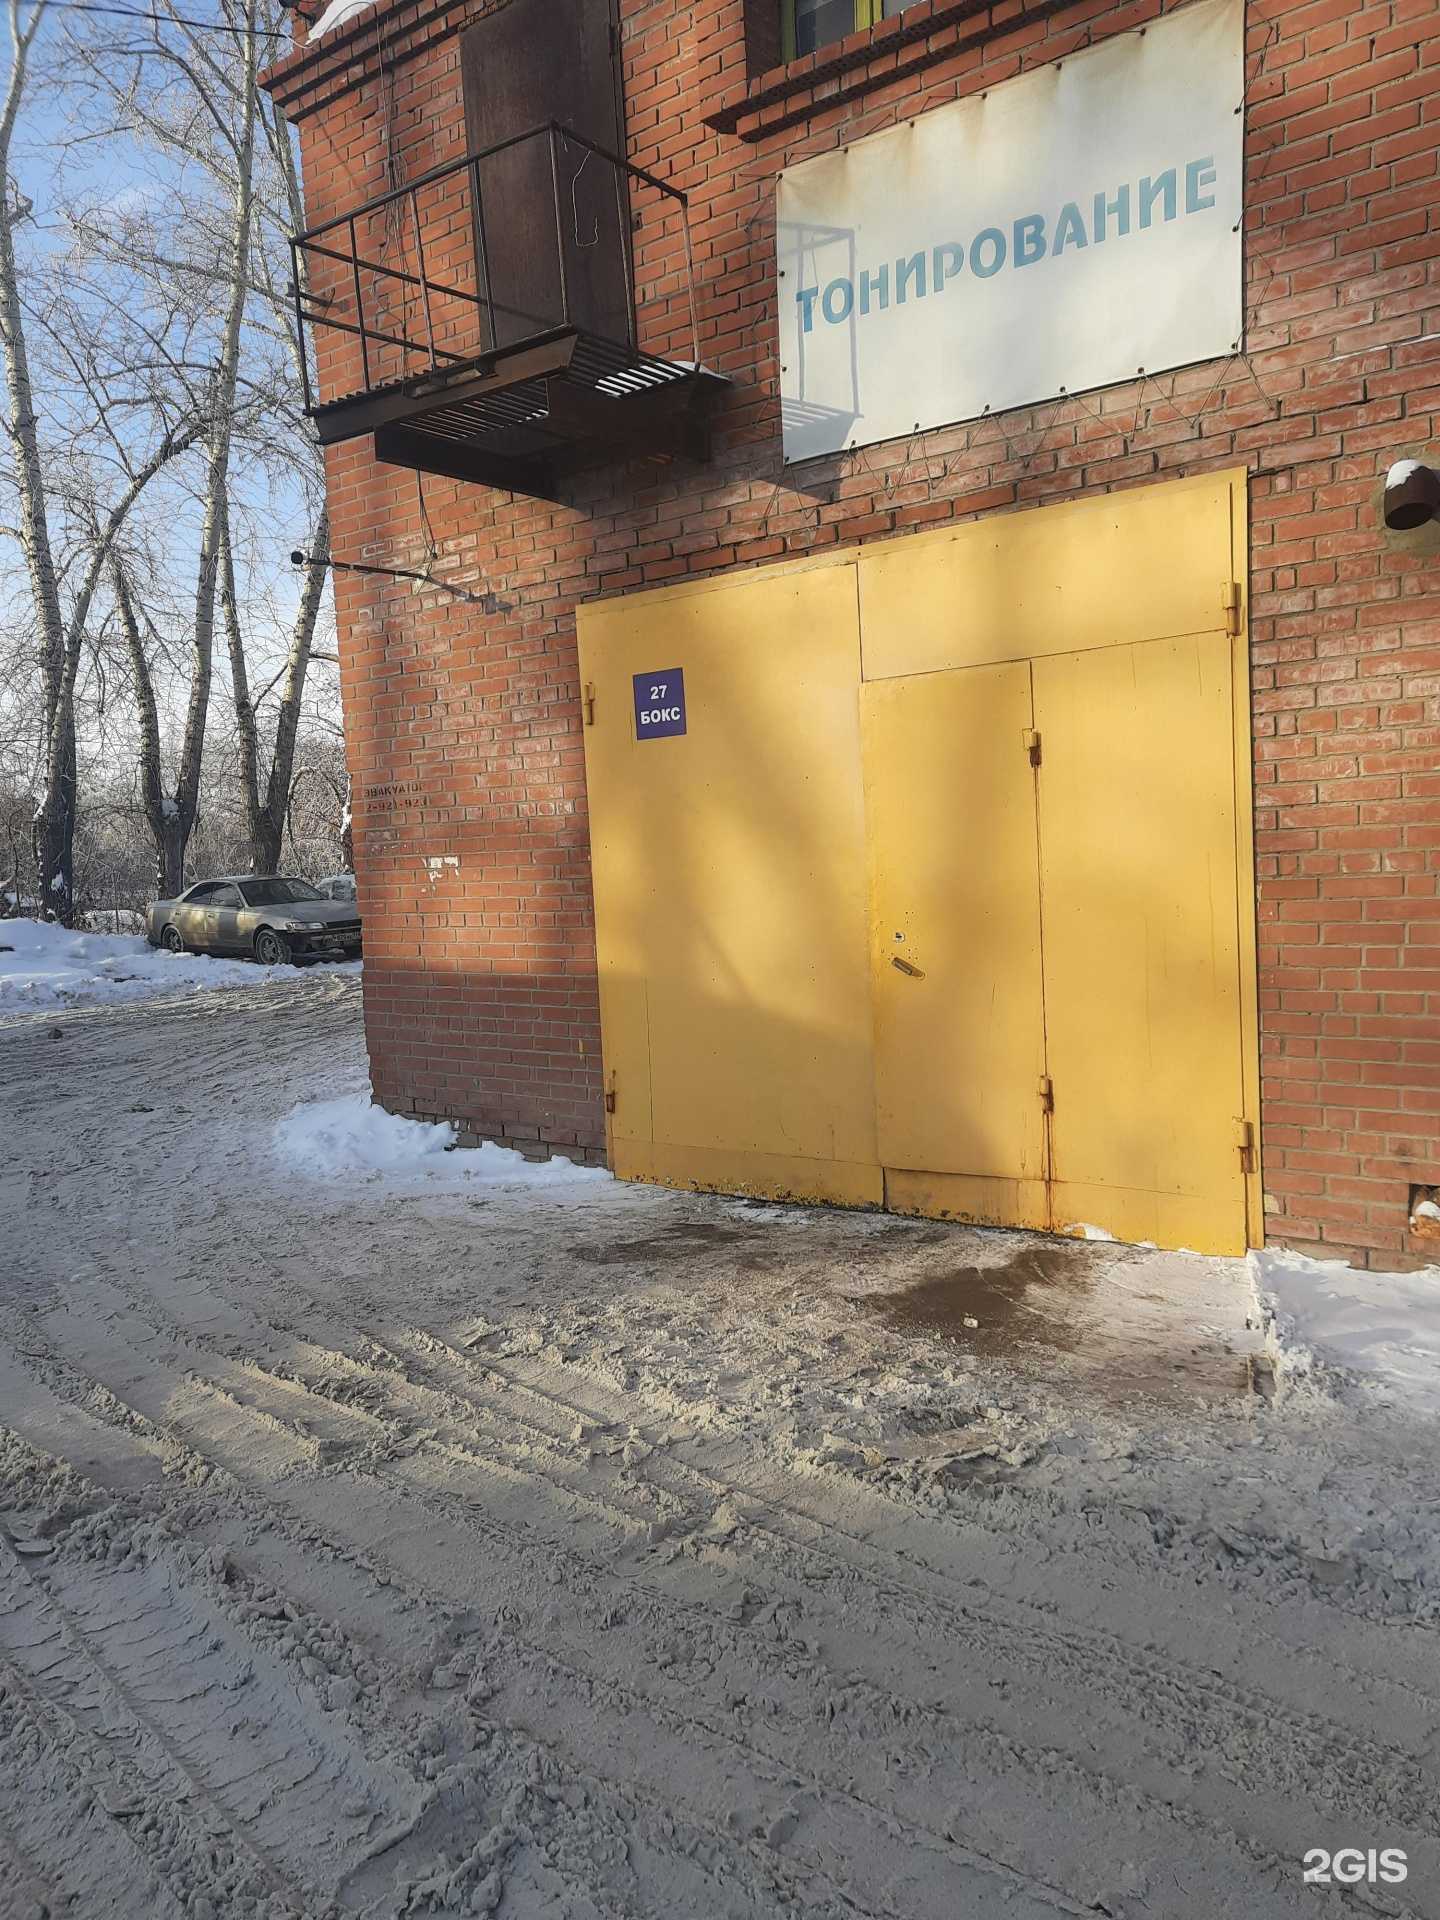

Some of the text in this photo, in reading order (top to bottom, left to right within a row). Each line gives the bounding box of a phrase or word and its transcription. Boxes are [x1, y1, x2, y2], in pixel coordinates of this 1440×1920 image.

[796, 156, 1217, 333] ТОНИРОВАНИЕ
[650, 685, 667, 699] 27
[640, 707, 680, 724] БОКС
